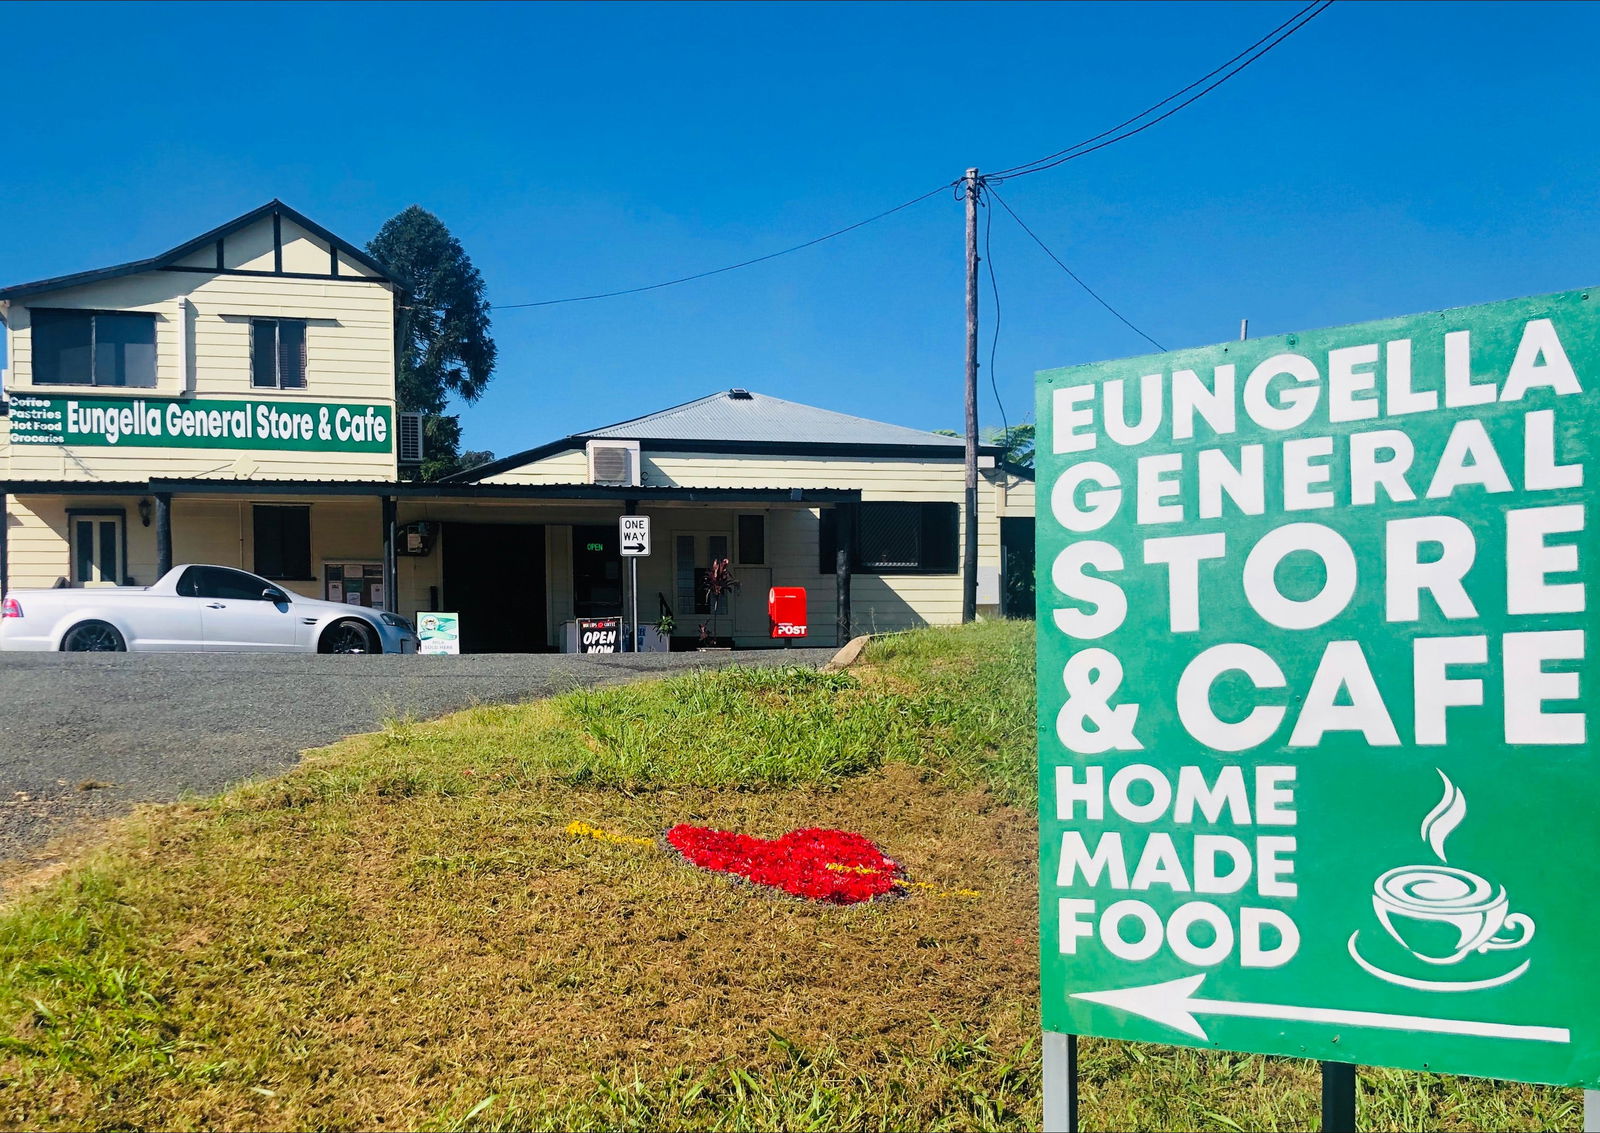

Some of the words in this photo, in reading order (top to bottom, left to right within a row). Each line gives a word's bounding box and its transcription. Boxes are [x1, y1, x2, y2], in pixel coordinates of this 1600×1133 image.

[1052, 318, 1583, 454] EUNGELLA
[10, 396, 51, 407] Coffee
[9, 408, 62, 419] Pastries
[10, 420, 32, 430] Hot
[34, 421, 62, 431] Food
[67, 400, 162, 444] Eungella
[166, 403, 252, 438] General
[256, 404, 314, 440] Store
[318, 406, 332, 440] &
[335, 407, 387, 442] Cafe
[10, 433, 64, 443] Groceries
[1051, 409, 1584, 532] GENERAL
[624, 519, 645, 529] ONE
[623, 532, 646, 541] WAY
[586, 543, 604, 551] OPEN
[1051, 503, 1586, 640] STORE
[777, 625, 807, 635] POST
[583, 630, 616, 645] OPEN
[586, 645, 614, 654] NOW
[1055, 647, 1145, 754] &
[1176, 629, 1587, 752] CAFE
[1055, 764, 1298, 825] HOME
[1056, 832, 1298, 897] MADE
[1058, 897, 1300, 968] FOOD
